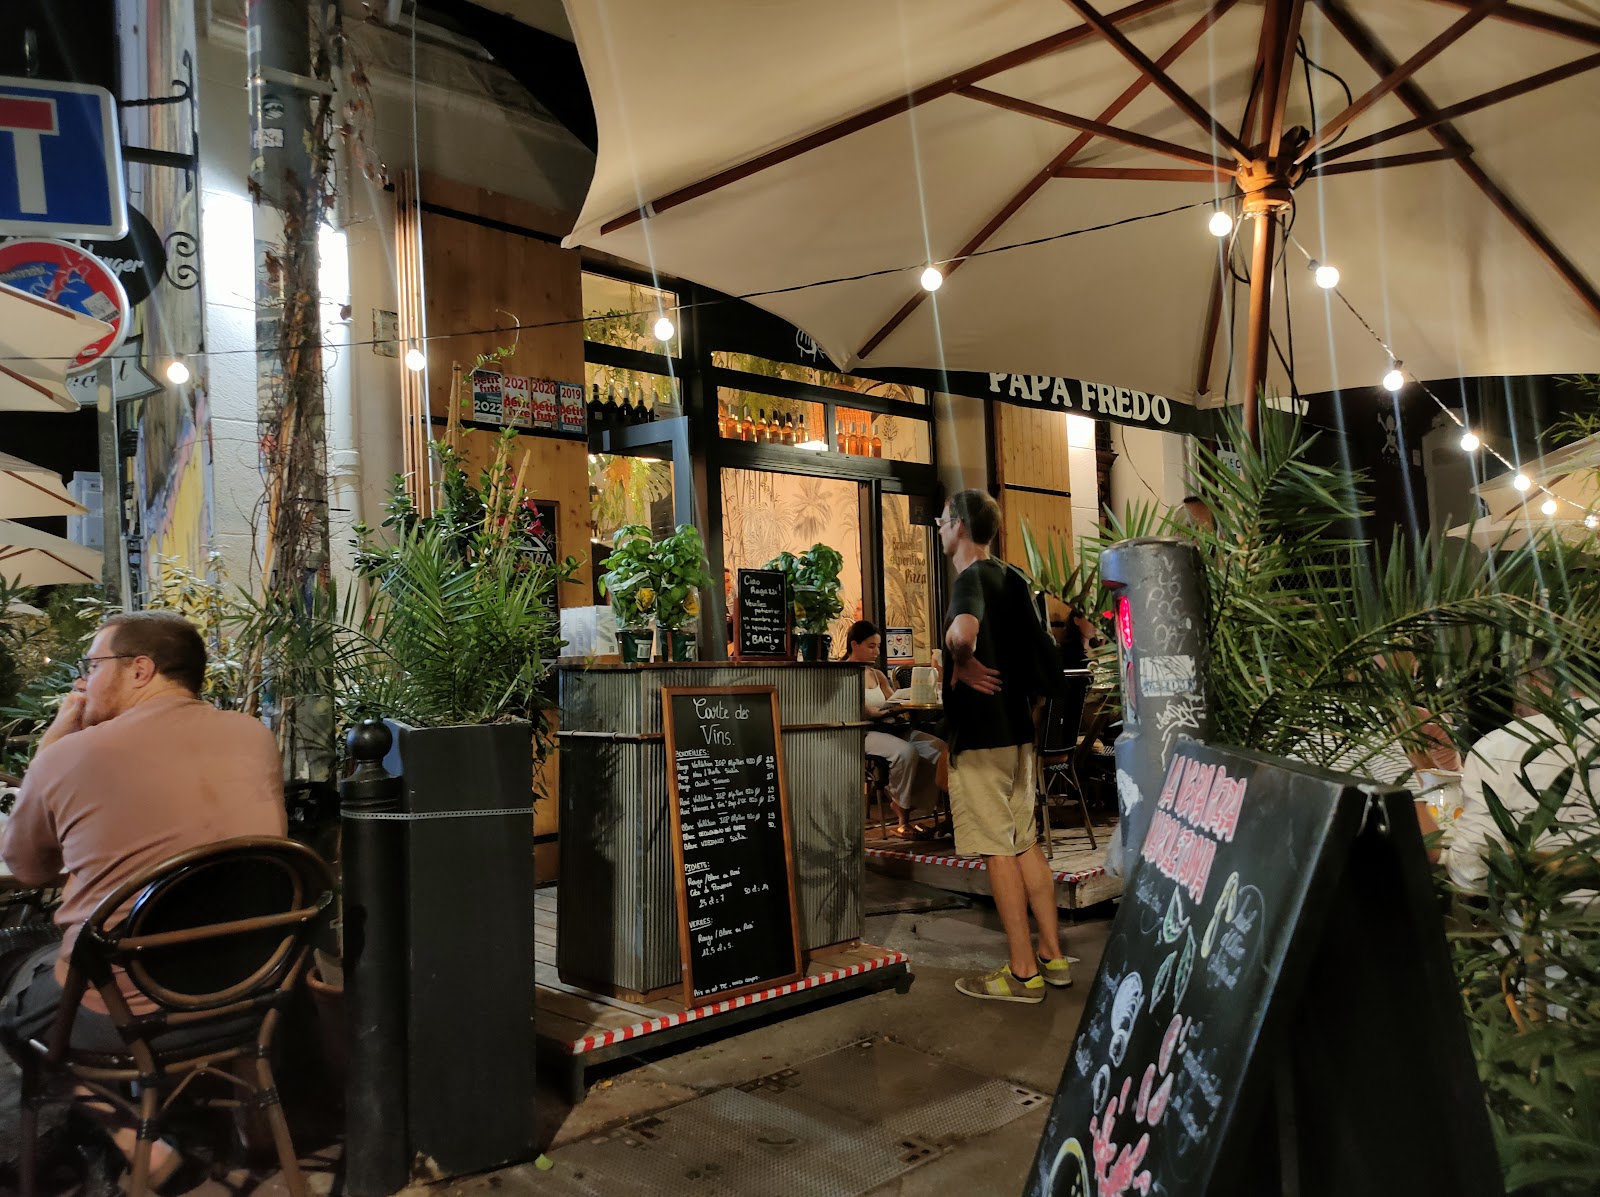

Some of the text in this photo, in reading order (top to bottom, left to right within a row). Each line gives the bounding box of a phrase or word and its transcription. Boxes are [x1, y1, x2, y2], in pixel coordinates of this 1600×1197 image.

[504, 377, 529, 390] 2021
[532, 381, 556, 395] 2020
[561, 387, 580, 399] 2019
[989, 373, 1171, 425] PAPA FREDO
[475, 400, 502, 413] 2022
[744, 575, 761, 585] Ciao
[905, 568, 927, 584] Pizza
[693, 698, 750, 720] Carte des
